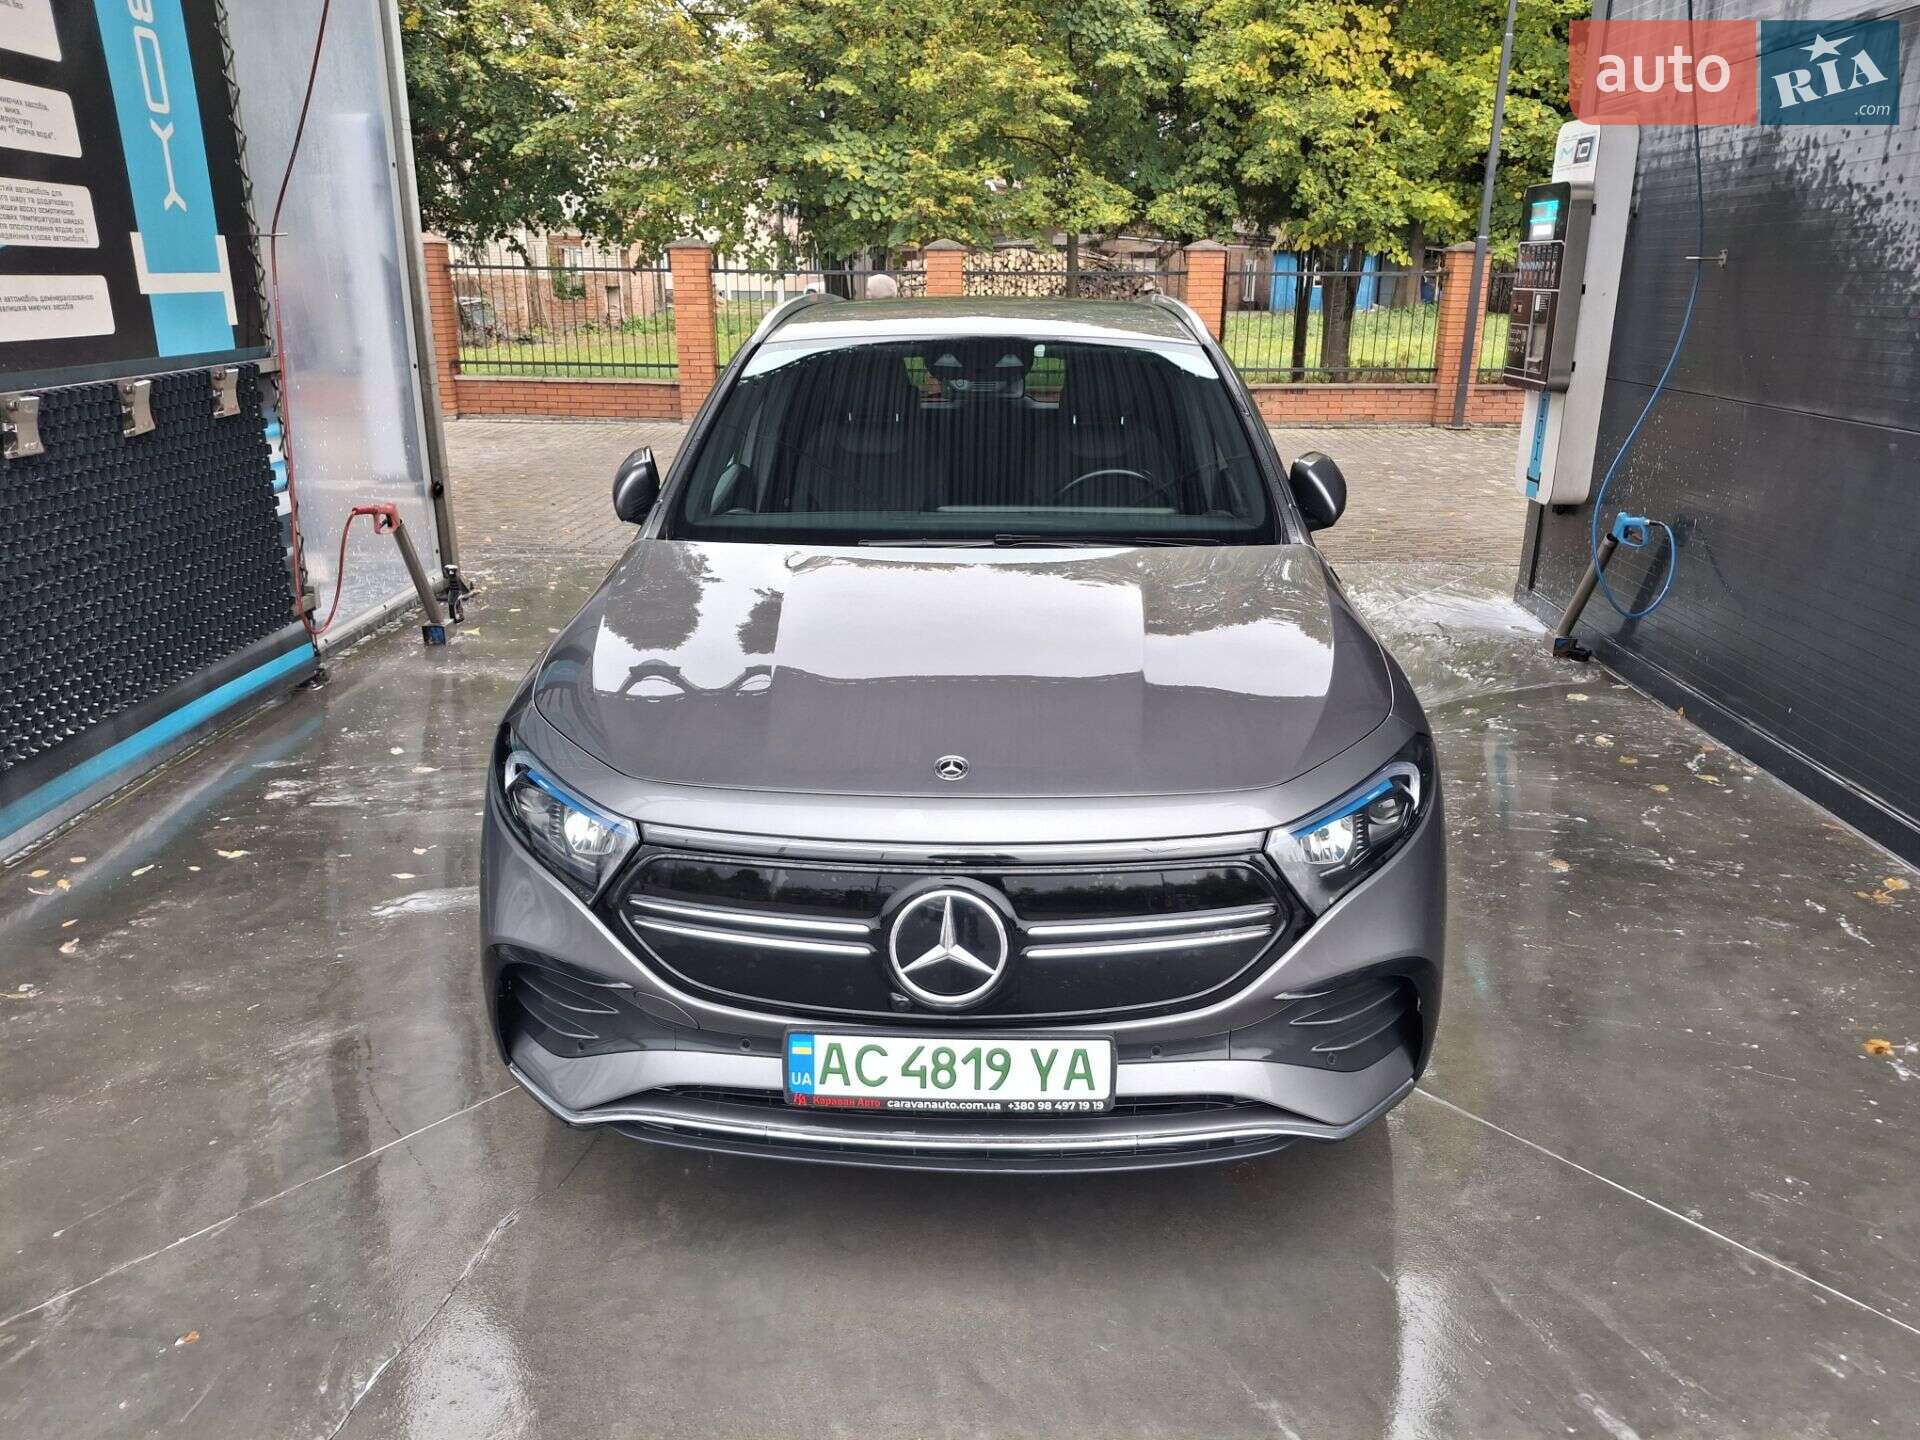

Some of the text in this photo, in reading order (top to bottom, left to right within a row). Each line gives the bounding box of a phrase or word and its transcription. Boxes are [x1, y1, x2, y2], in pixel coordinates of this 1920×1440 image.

[16, 186, 50, 197] автомобіль
[4, 293, 38, 302] автомобіль
[819, 1042, 1096, 1092] AC 4819 YA
[791, 1071, 812, 1085] UA
[887, 1099, 1105, 1111] caravanauto.com.ua +380 98 497 19 19
